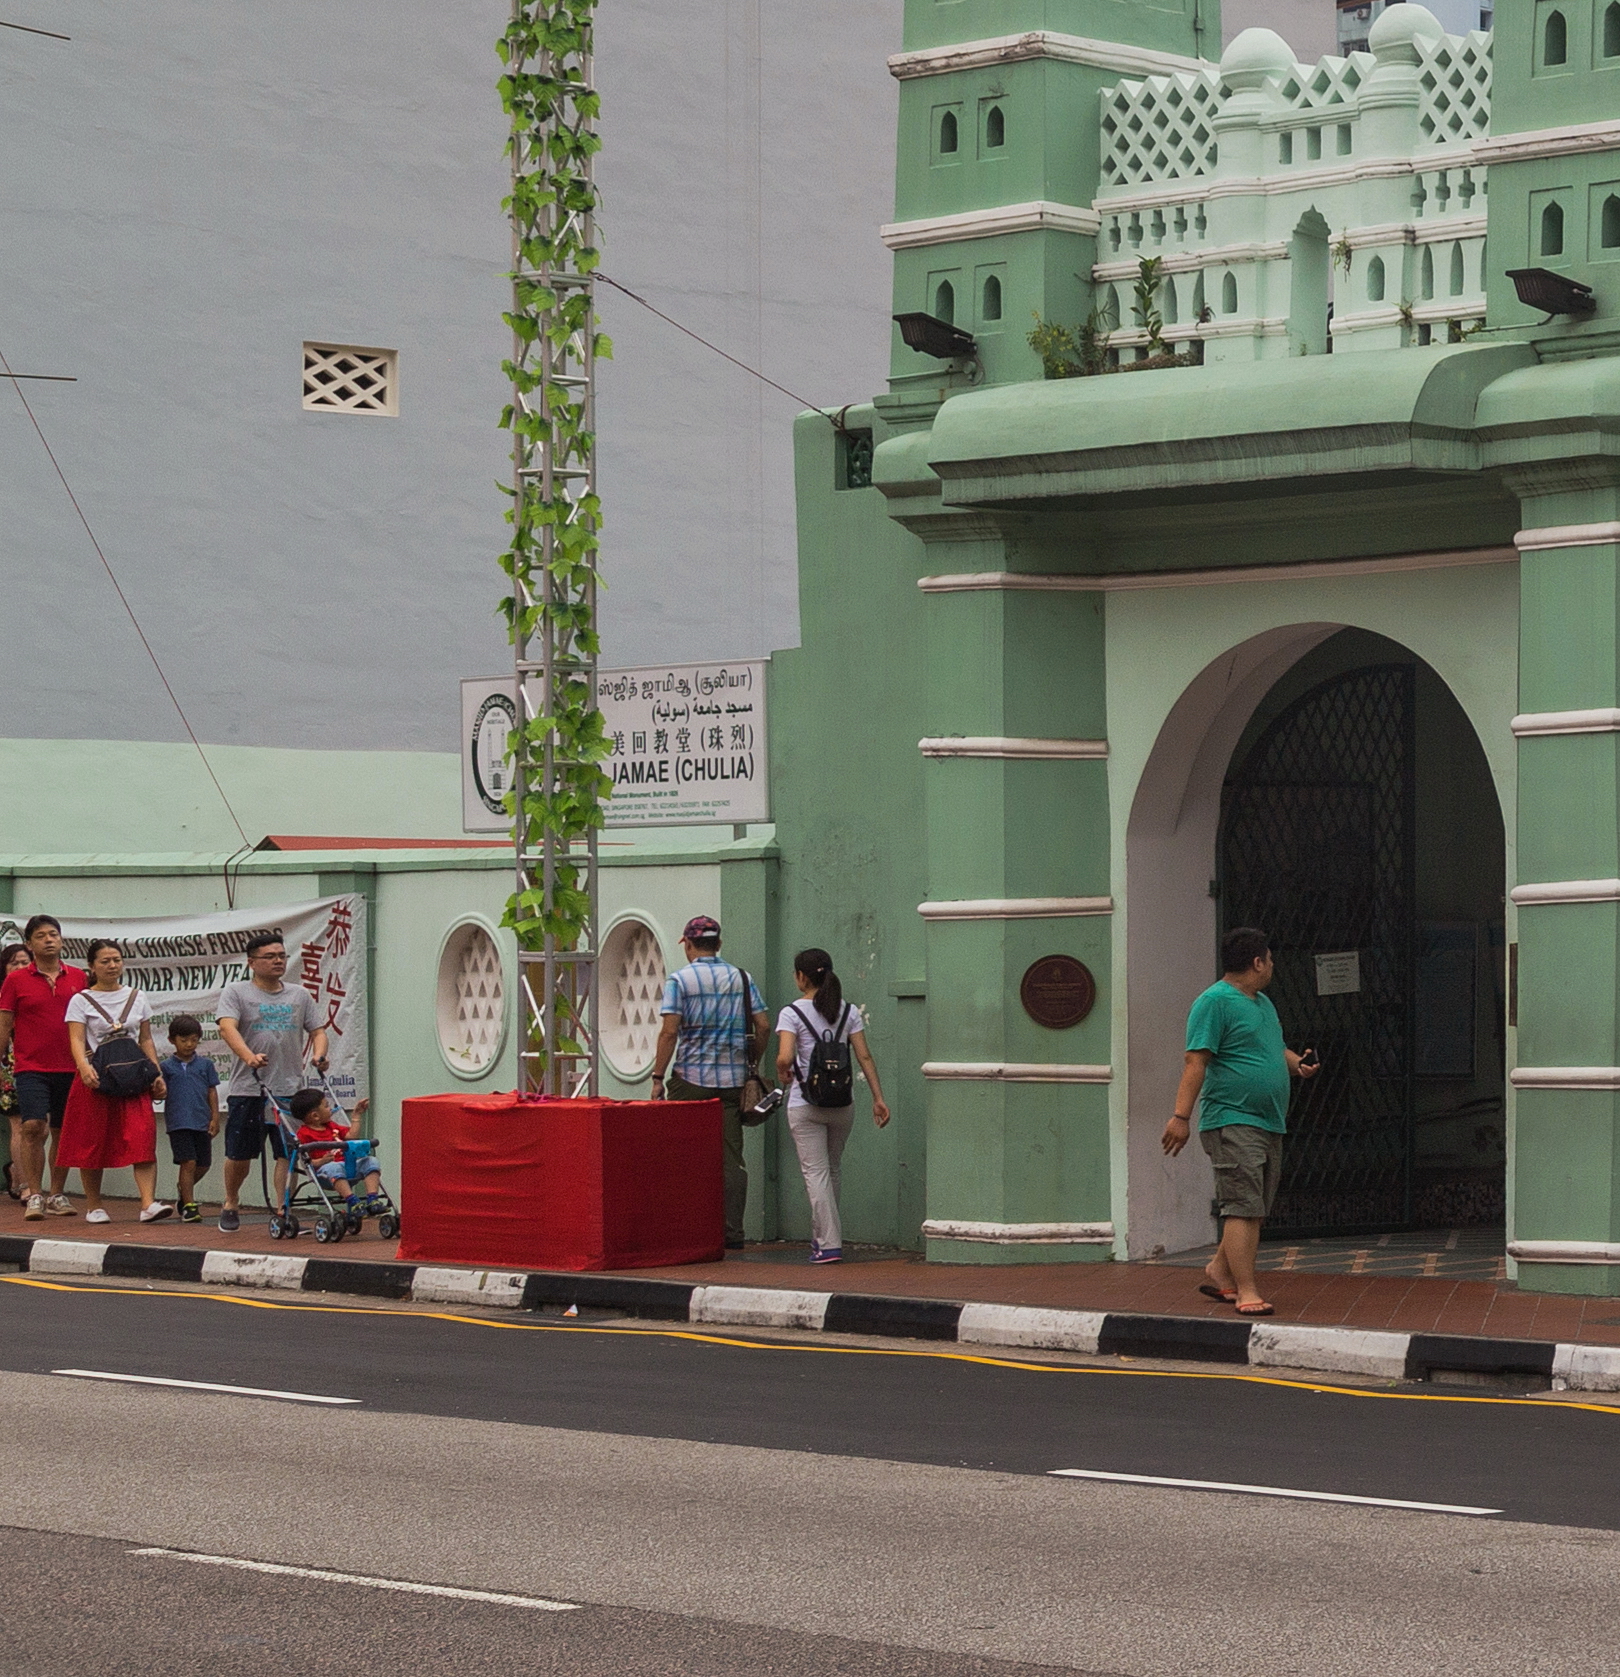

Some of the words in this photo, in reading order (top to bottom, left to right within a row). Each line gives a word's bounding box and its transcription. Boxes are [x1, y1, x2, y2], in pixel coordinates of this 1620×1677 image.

[611, 760, 670, 785] JAMAE
[674, 752, 754, 785] (CHULIA)
[135, 934, 208, 959] CHINESE
[206, 927, 283, 955] FRIE
[174, 964, 219, 992] NEW
[220, 963, 255, 989] YEA
